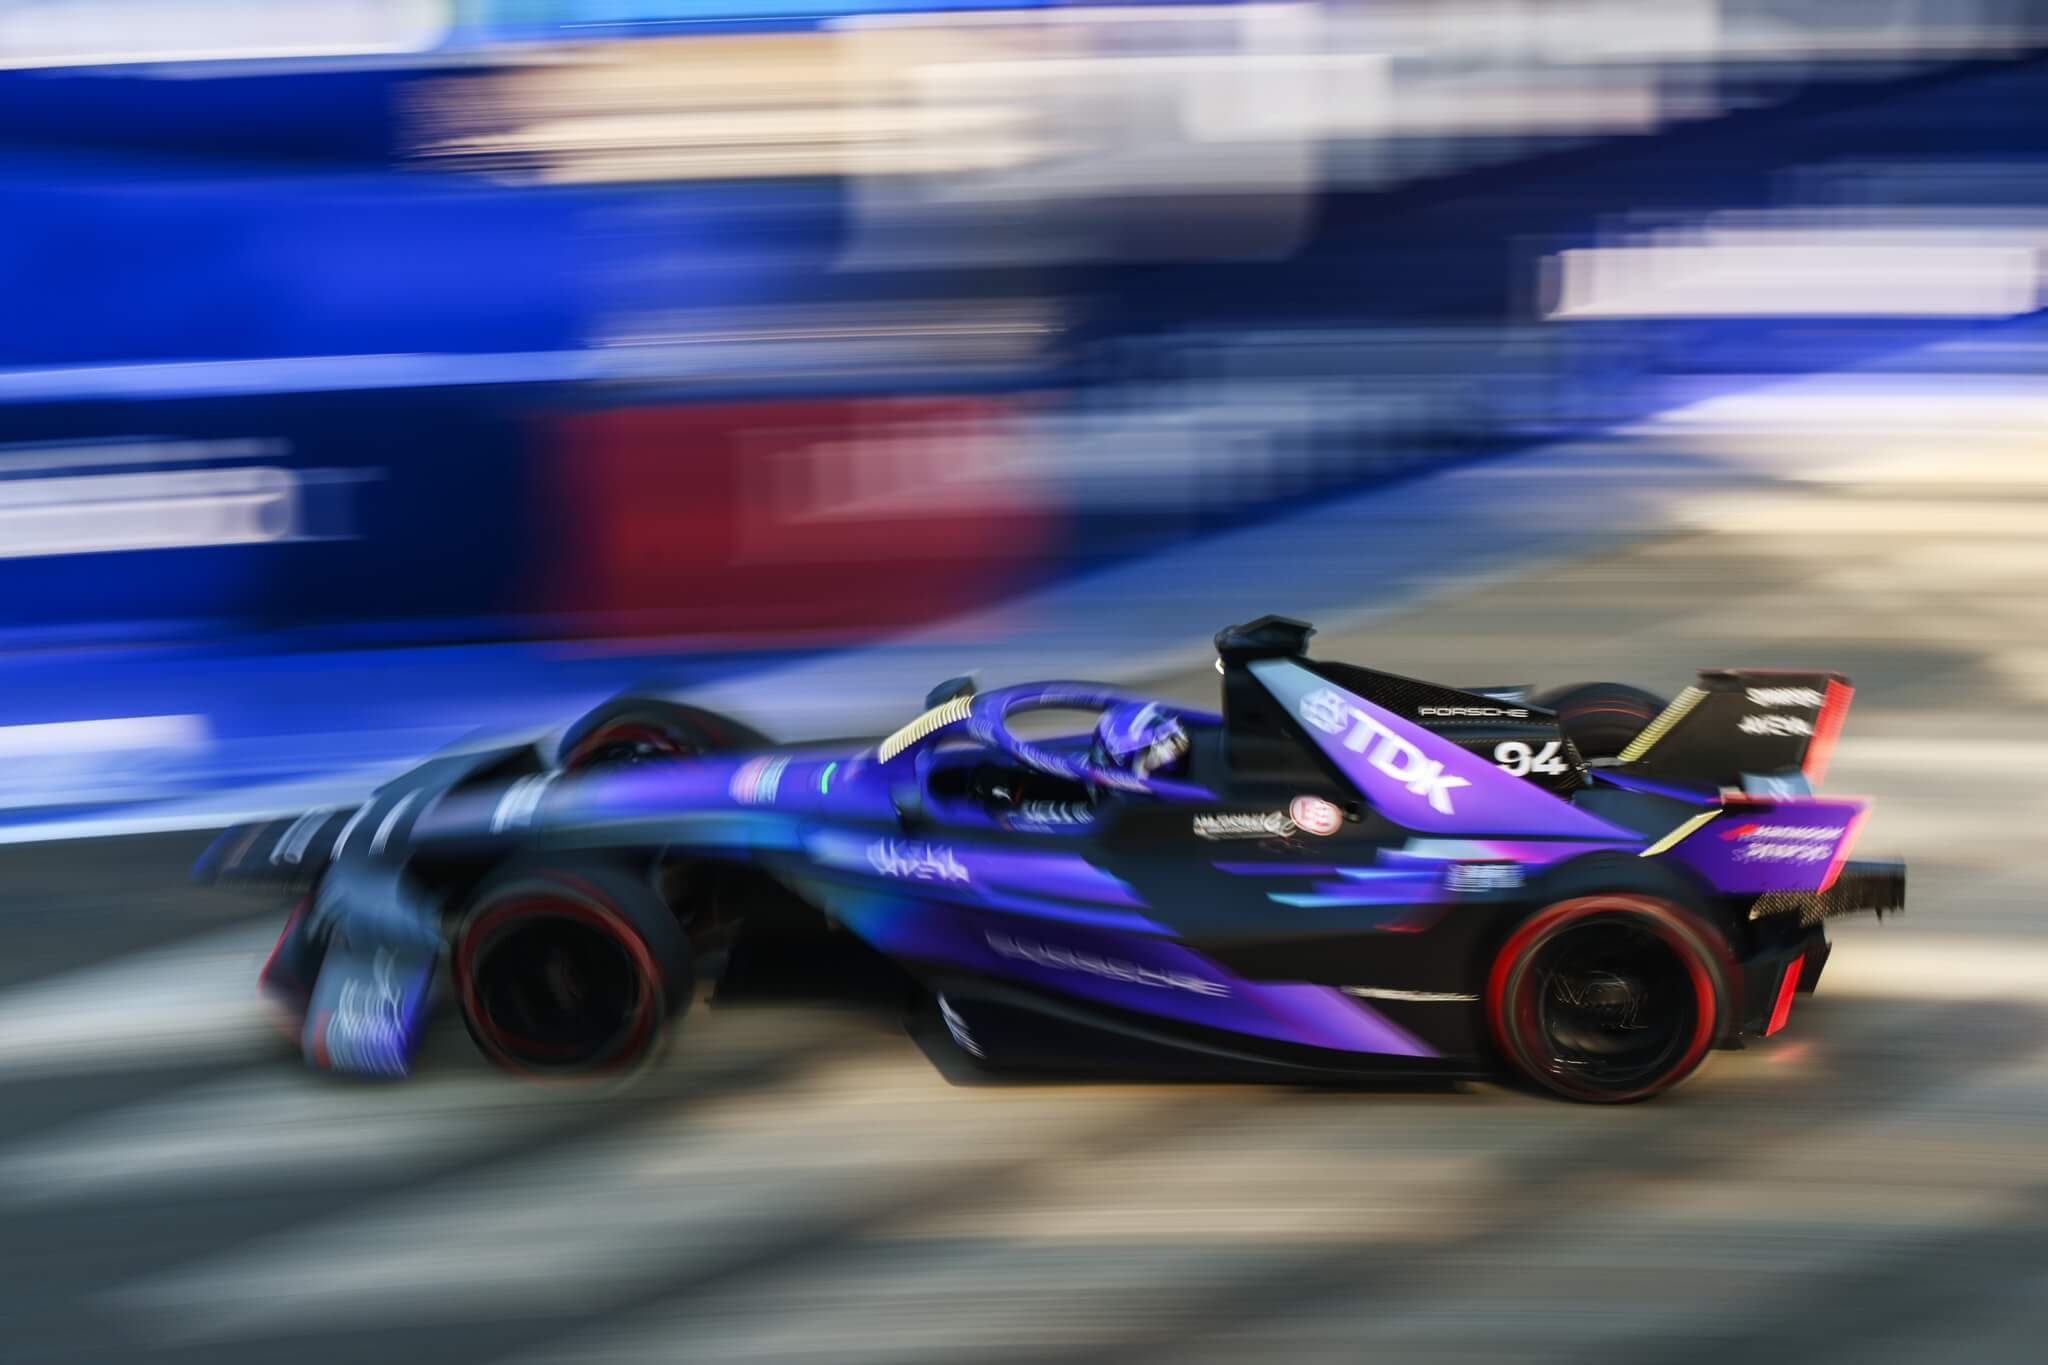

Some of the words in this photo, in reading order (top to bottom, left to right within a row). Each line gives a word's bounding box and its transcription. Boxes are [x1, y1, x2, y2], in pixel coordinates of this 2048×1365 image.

[1418, 706, 1529, 718] PORSCHE
[1343, 706, 1473, 815] TDK
[1494, 741, 1568, 777] 94
